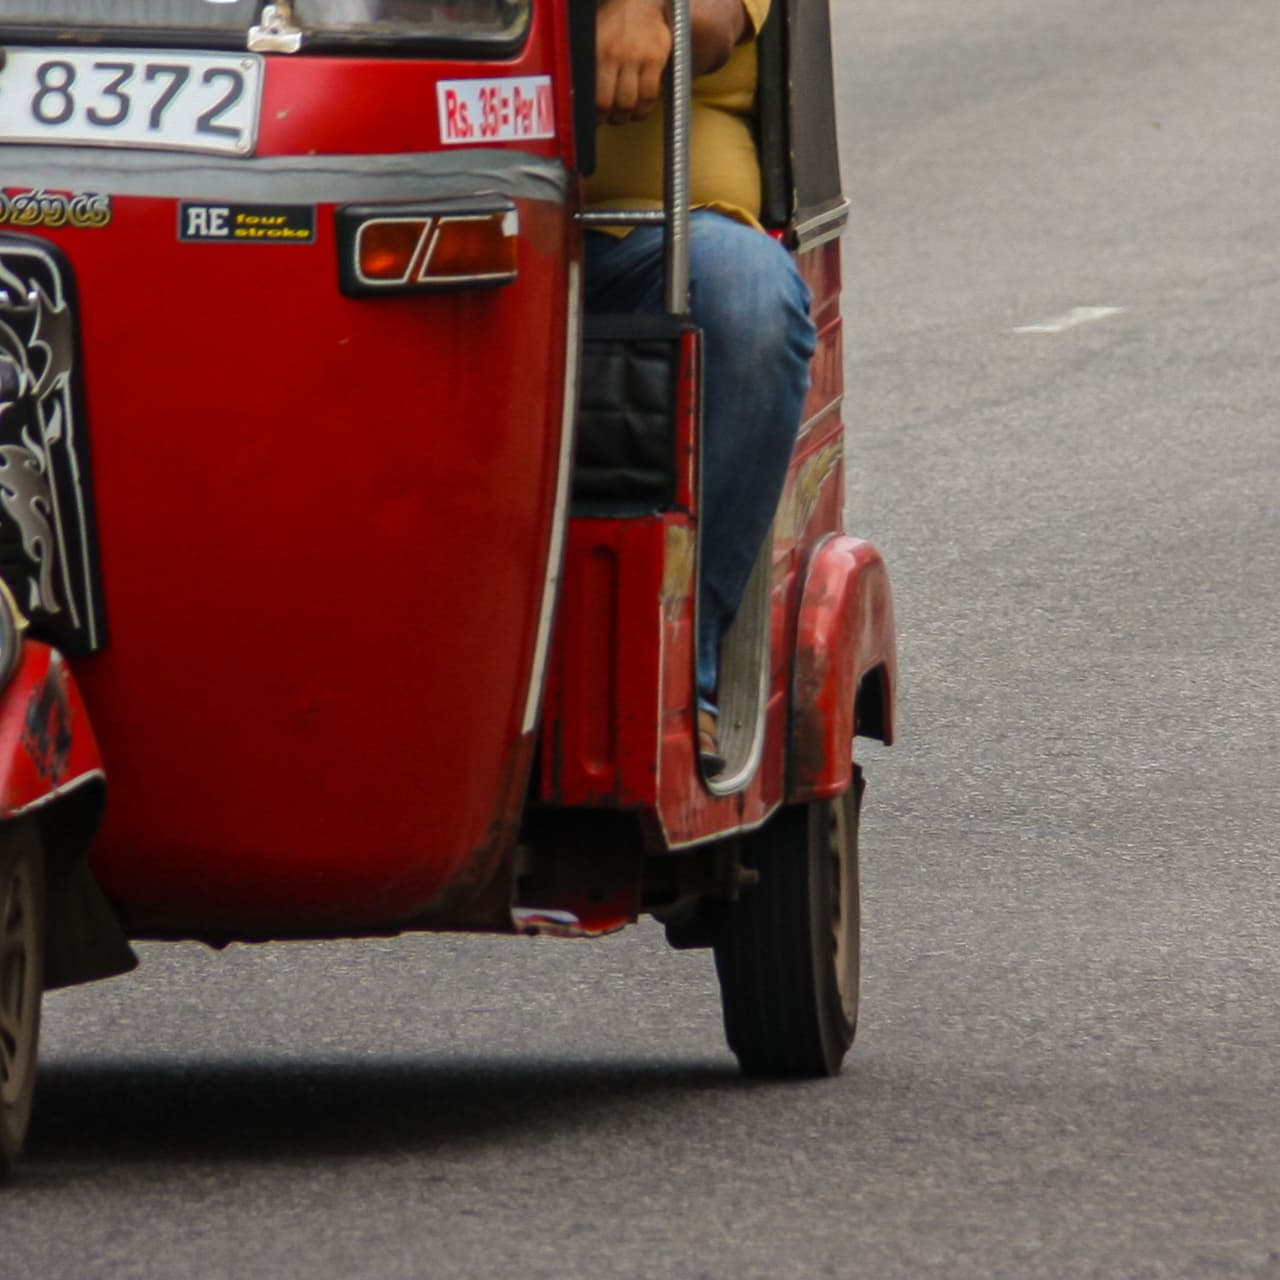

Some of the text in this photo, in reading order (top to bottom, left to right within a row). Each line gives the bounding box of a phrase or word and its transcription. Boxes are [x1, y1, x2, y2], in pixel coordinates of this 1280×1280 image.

[31, 61, 245, 138] 8372
[187, 207, 287, 236] RE four
[234, 227, 310, 238] stroke
